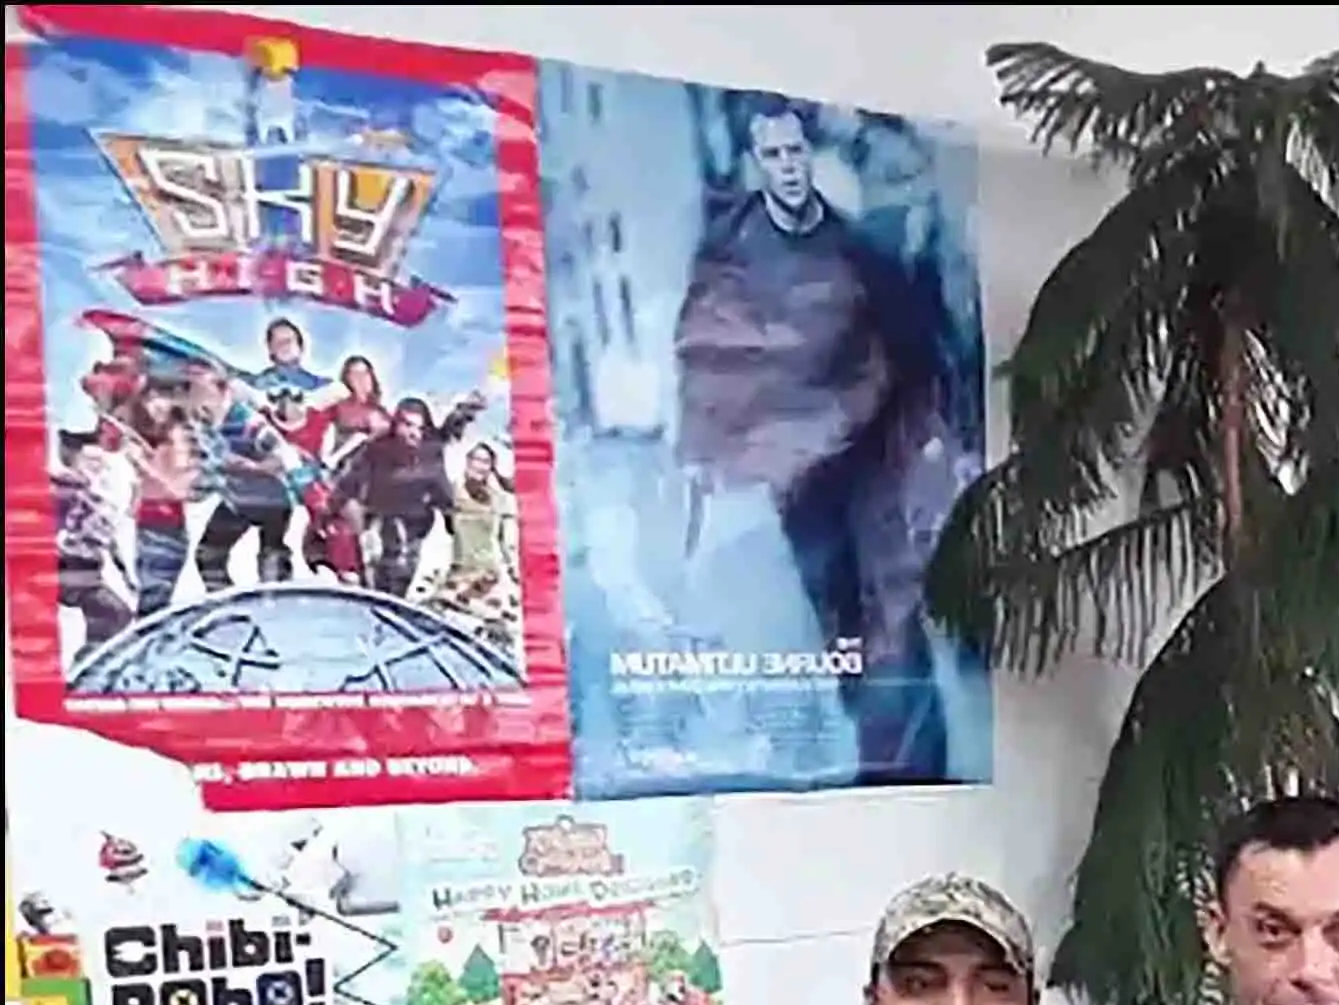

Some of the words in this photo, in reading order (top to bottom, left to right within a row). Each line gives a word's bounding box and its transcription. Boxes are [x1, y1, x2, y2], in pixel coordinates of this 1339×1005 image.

[137, 149, 412, 258] SKY
[164, 255, 396, 316] HIGH
[332, 758, 382, 778] AND
